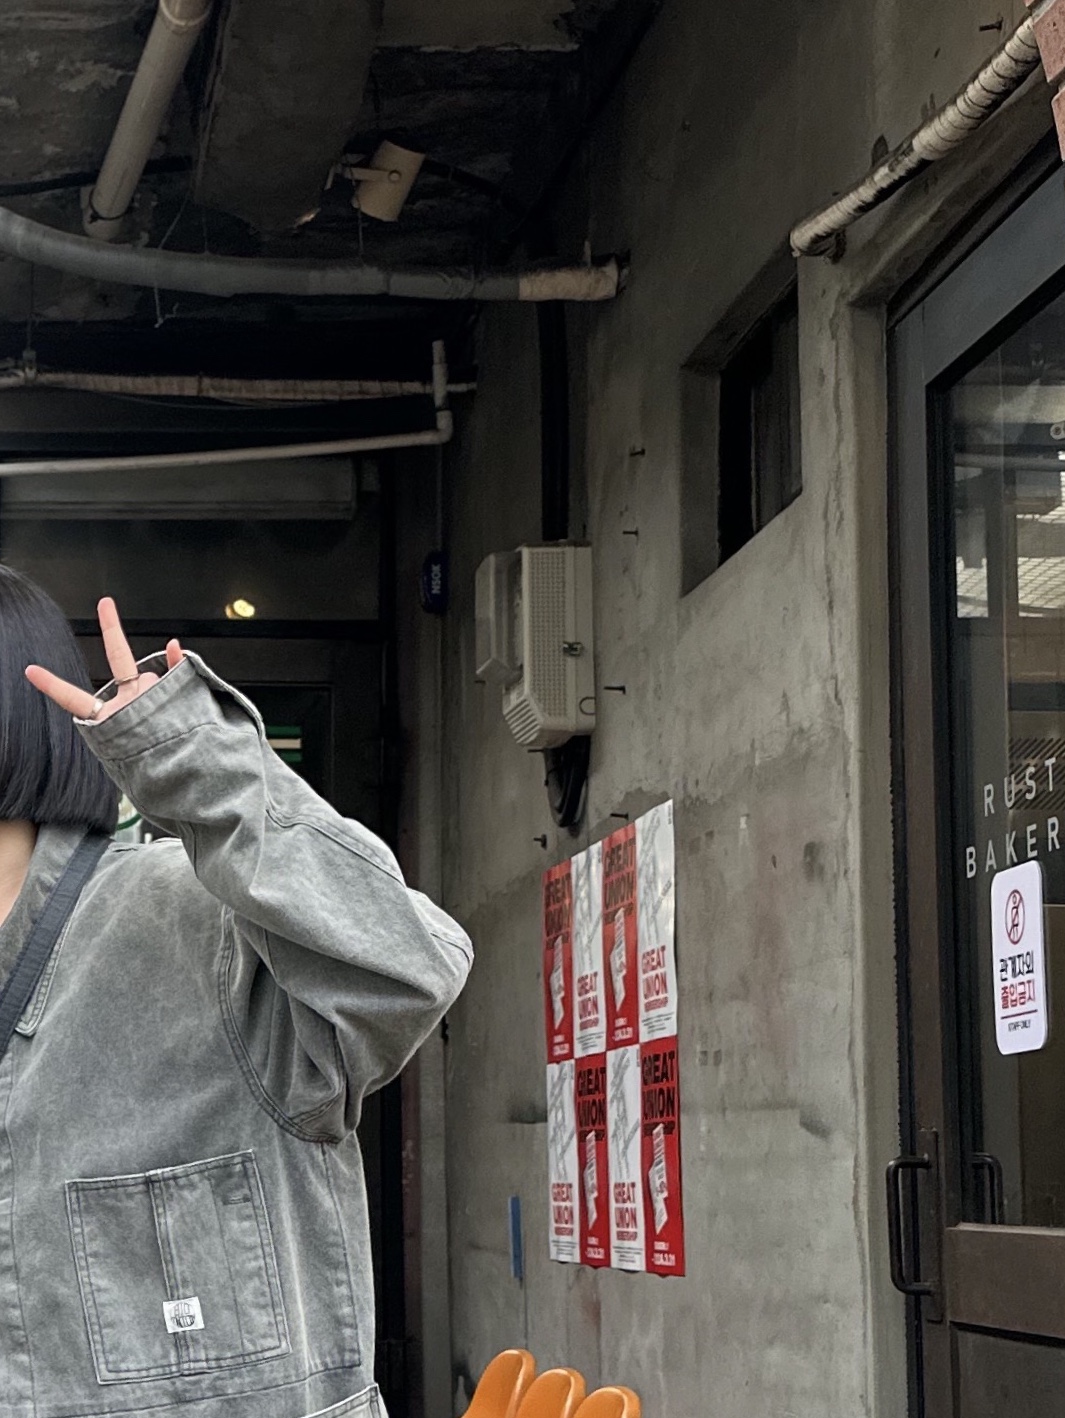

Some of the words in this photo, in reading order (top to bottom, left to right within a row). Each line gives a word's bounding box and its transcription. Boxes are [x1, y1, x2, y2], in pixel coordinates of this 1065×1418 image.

[983, 757, 1056, 817] RUST
[642, 945, 666, 975] GREAT
[1000, 950, 1034, 981] 관계자외
[643, 971, 668, 1000] UNION
[1001, 979, 1036, 1009] 출입금지
[578, 1067, 606, 1097] GREAT
[642, 1051, 675, 1086] GREAT
[578, 1099, 606, 1128] UNION
[642, 1087, 675, 1120] UNION
